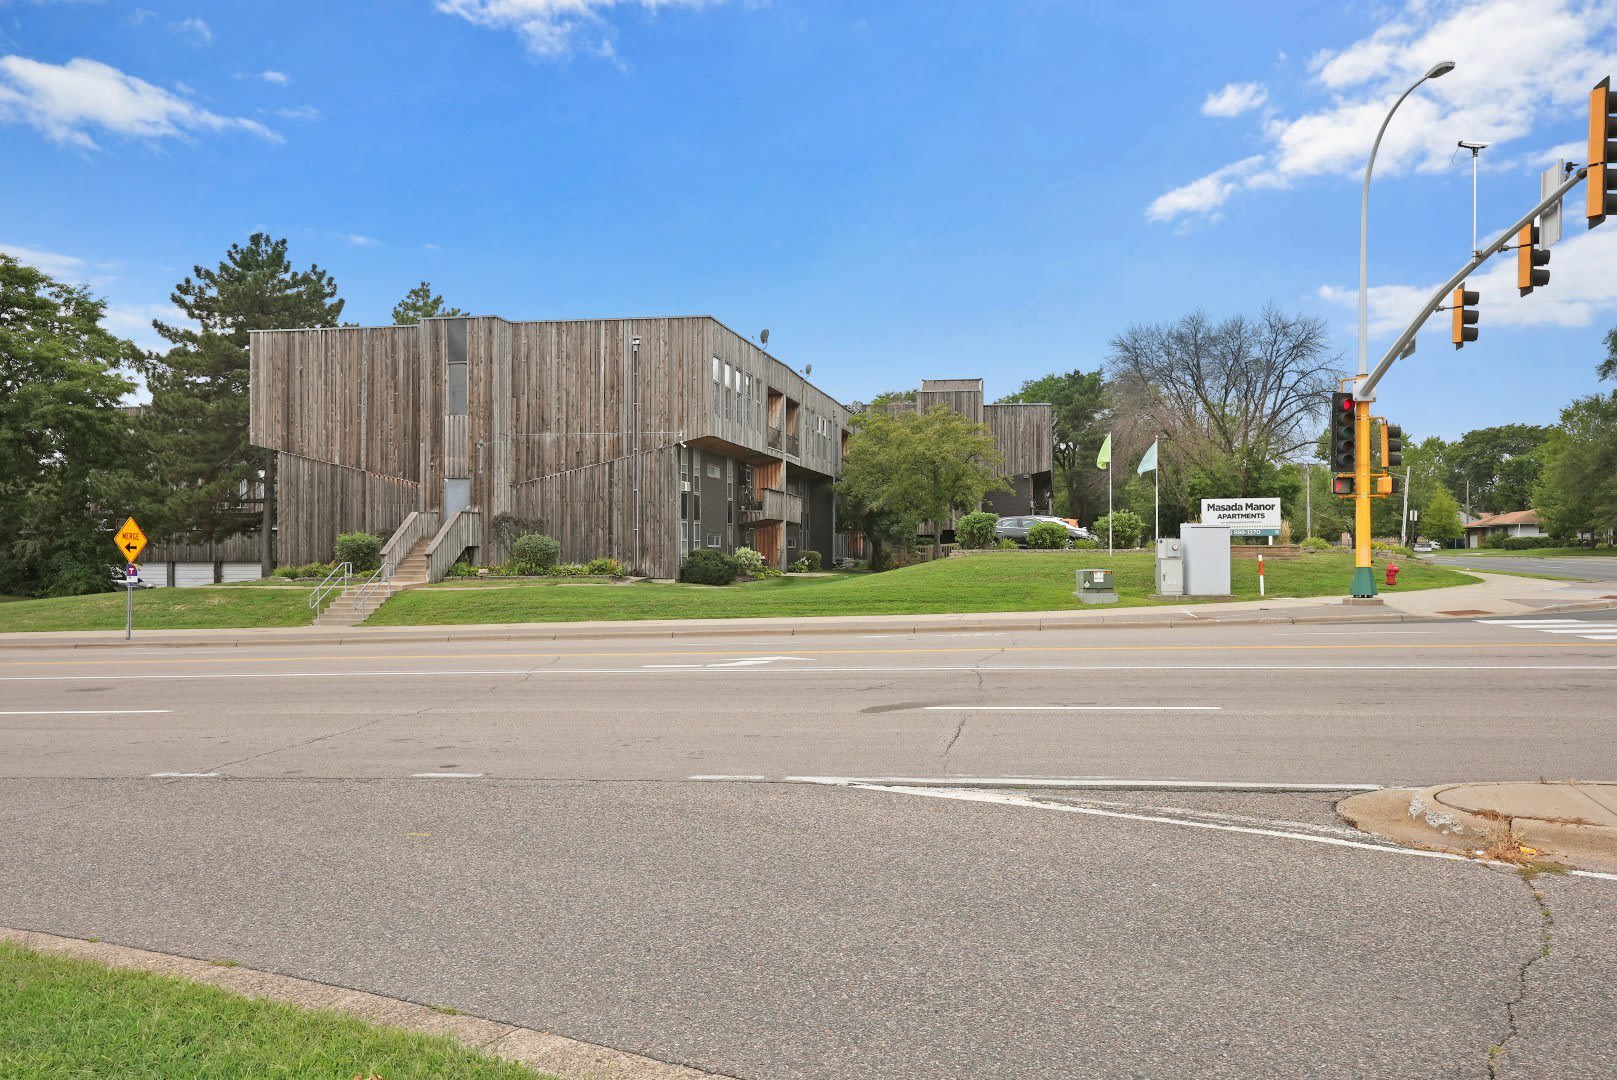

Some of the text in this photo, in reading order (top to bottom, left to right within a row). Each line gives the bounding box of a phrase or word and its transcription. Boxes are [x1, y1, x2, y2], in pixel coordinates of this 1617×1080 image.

[1207, 503, 1275, 512] Masada Manor
[122, 532, 140, 540] MERGE
